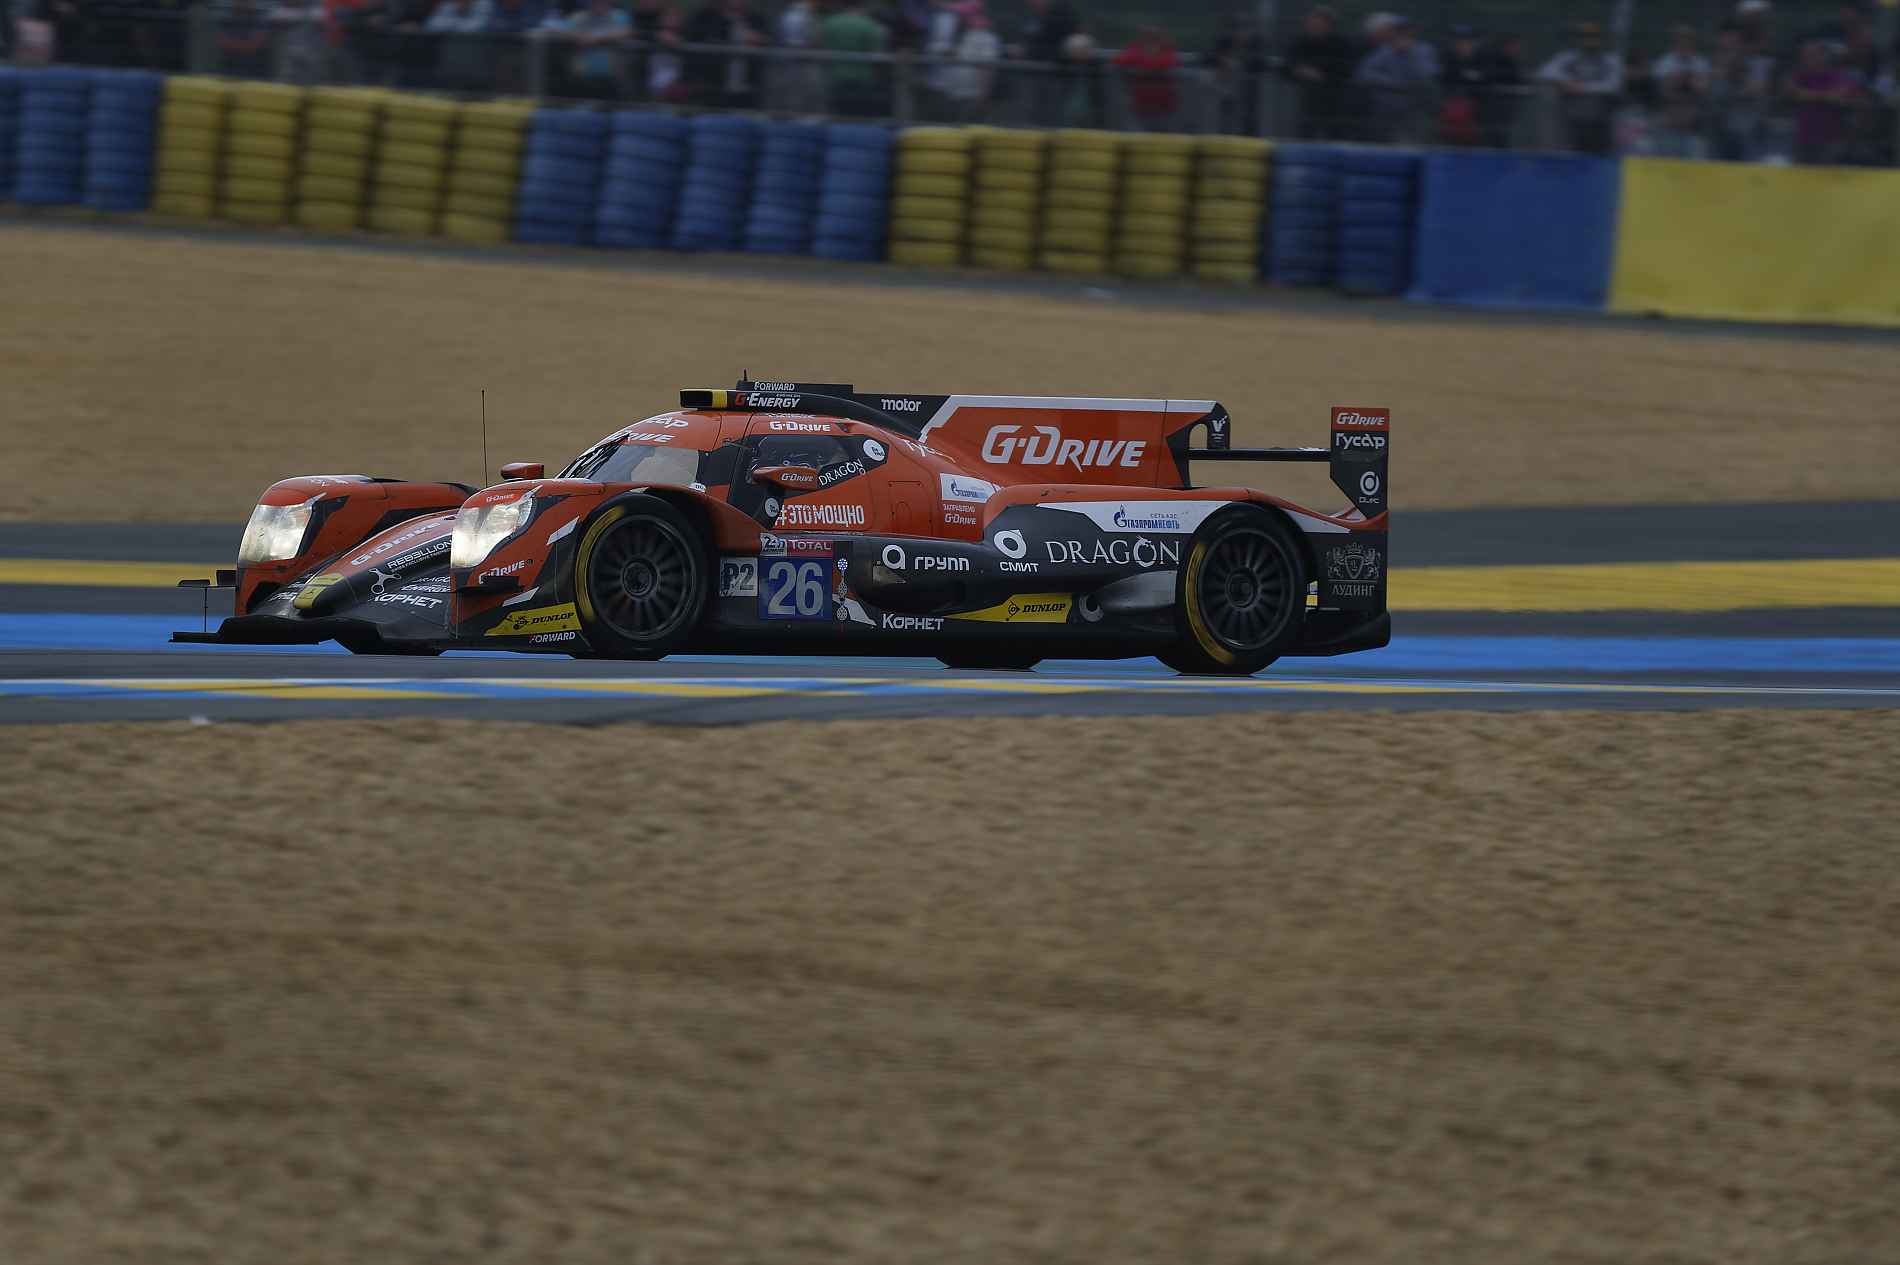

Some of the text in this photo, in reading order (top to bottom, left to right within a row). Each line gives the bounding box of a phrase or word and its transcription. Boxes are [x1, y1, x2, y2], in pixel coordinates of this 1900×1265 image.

[754, 381, 795, 391] FORWARD
[881, 398, 922, 412] motor
[818, 458, 864, 486] DRAGON
[788, 539, 832, 551] TOTAL
[1045, 535, 1180, 568] DRAGON
[767, 561, 824, 616] 26
[1022, 603, 1066, 613] DUNLOP
[530, 612, 575, 625] DUNLOP
